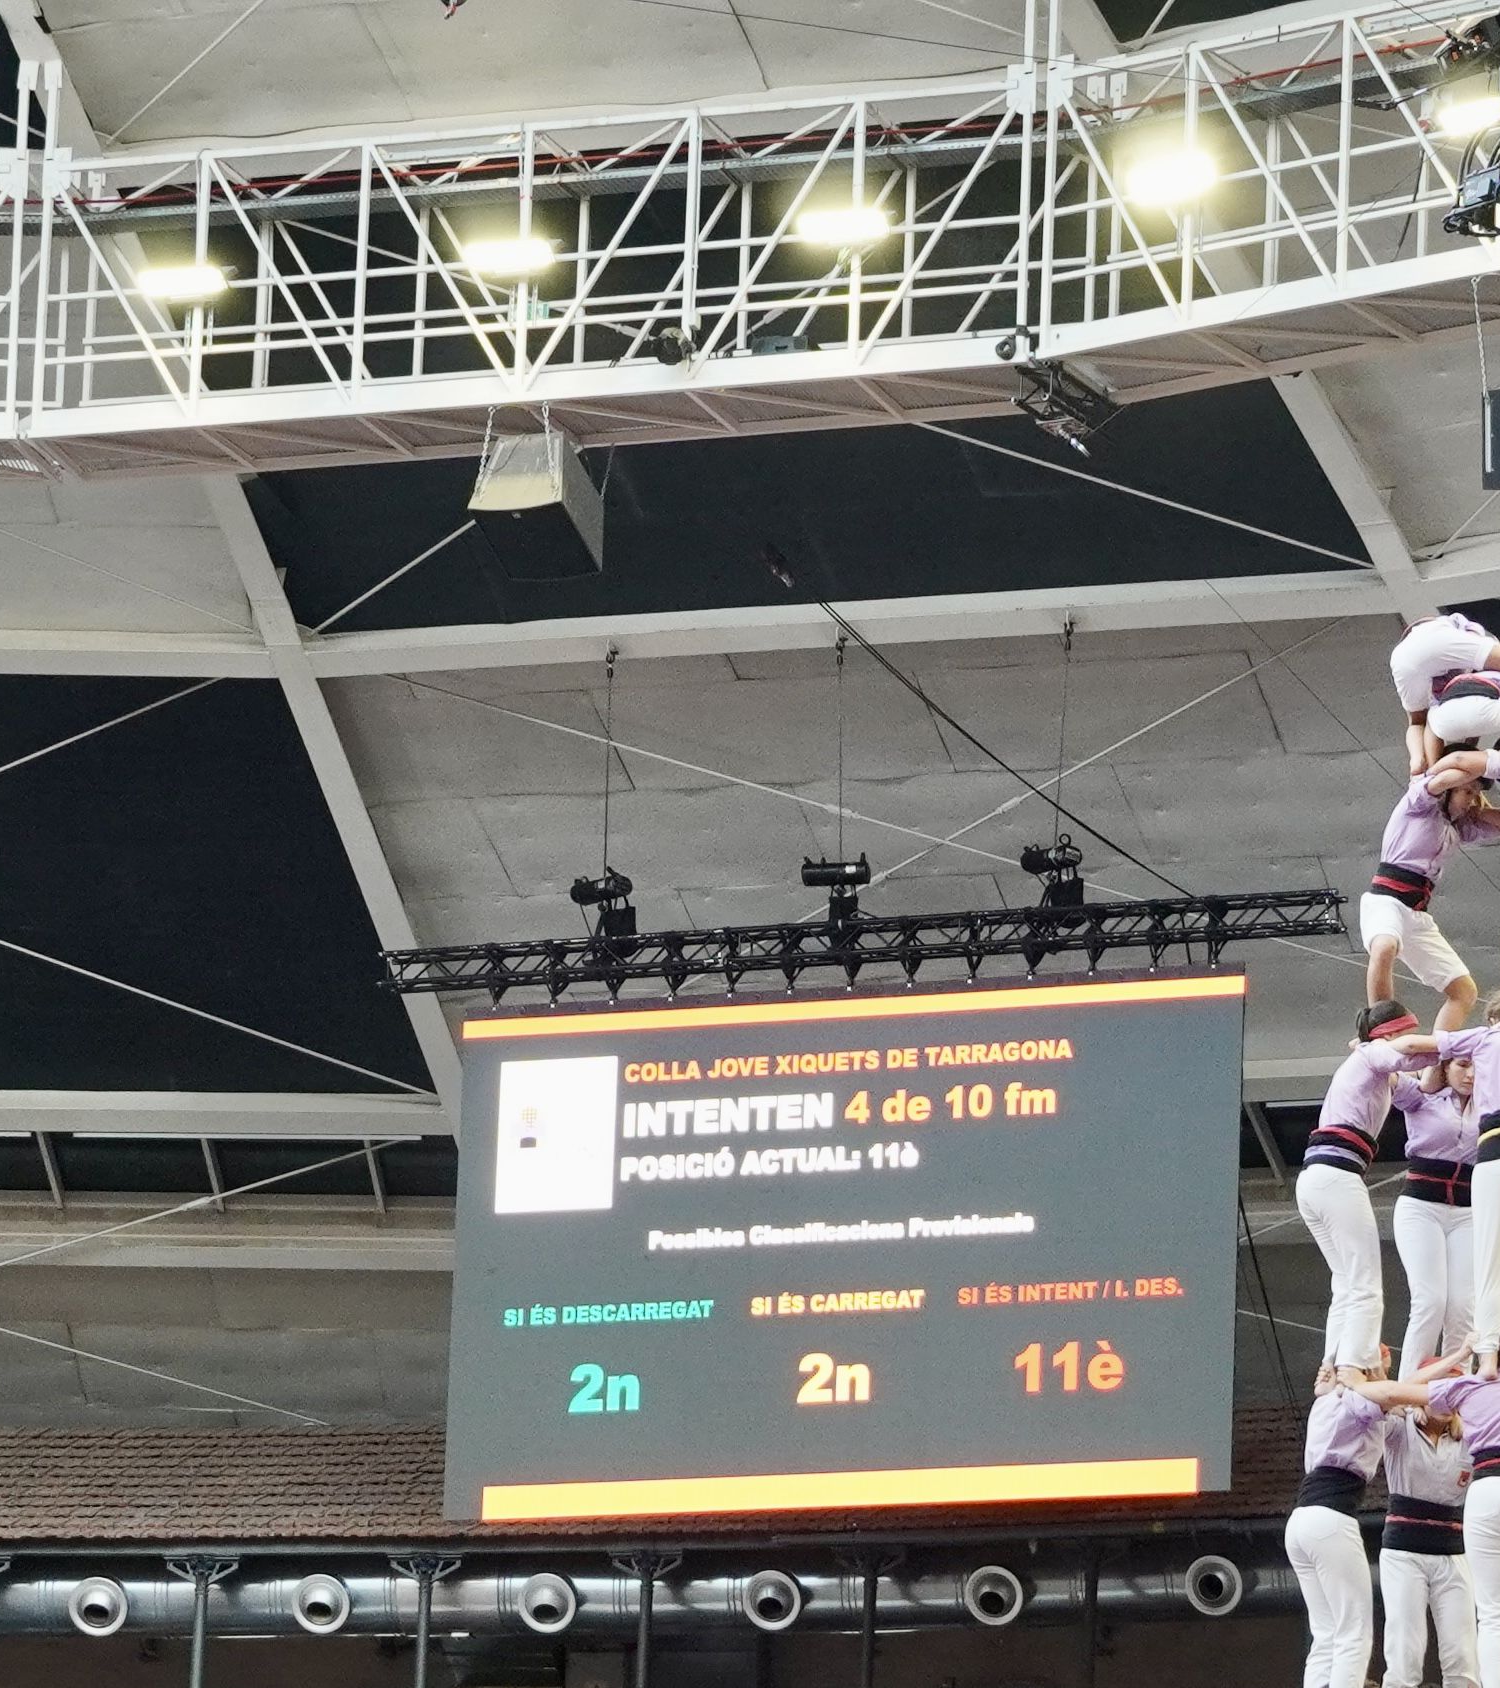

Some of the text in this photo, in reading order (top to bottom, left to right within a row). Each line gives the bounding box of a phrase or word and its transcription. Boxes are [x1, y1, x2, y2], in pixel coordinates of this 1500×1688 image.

[624, 1039, 1073, 1084] COLLA JOVE XIQUETS DE TARRAGONA
[622, 1081, 1057, 1138] INTENTEN 4 de 10 fm
[619, 1141, 919, 1182] POSICIÓ ACTUAL: 11è
[648, 1212, 1034, 1252] Possibles Classificacions Provisionals
[750, 1289, 925, 1316] SI ÉS CARREGAT
[958, 1285, 979, 1304] SI
[985, 1279, 1012, 1303] ÉS
[1019, 1280, 1098, 1302] INTENT
[1135, 1276, 1183, 1297] DES.
[503, 1299, 714, 1327] SI ÉS DESCARREGAT
[568, 1363, 640, 1413] 2n
[797, 1353, 870, 1404] 2n
[1014, 1342, 1124, 1394] 11è
